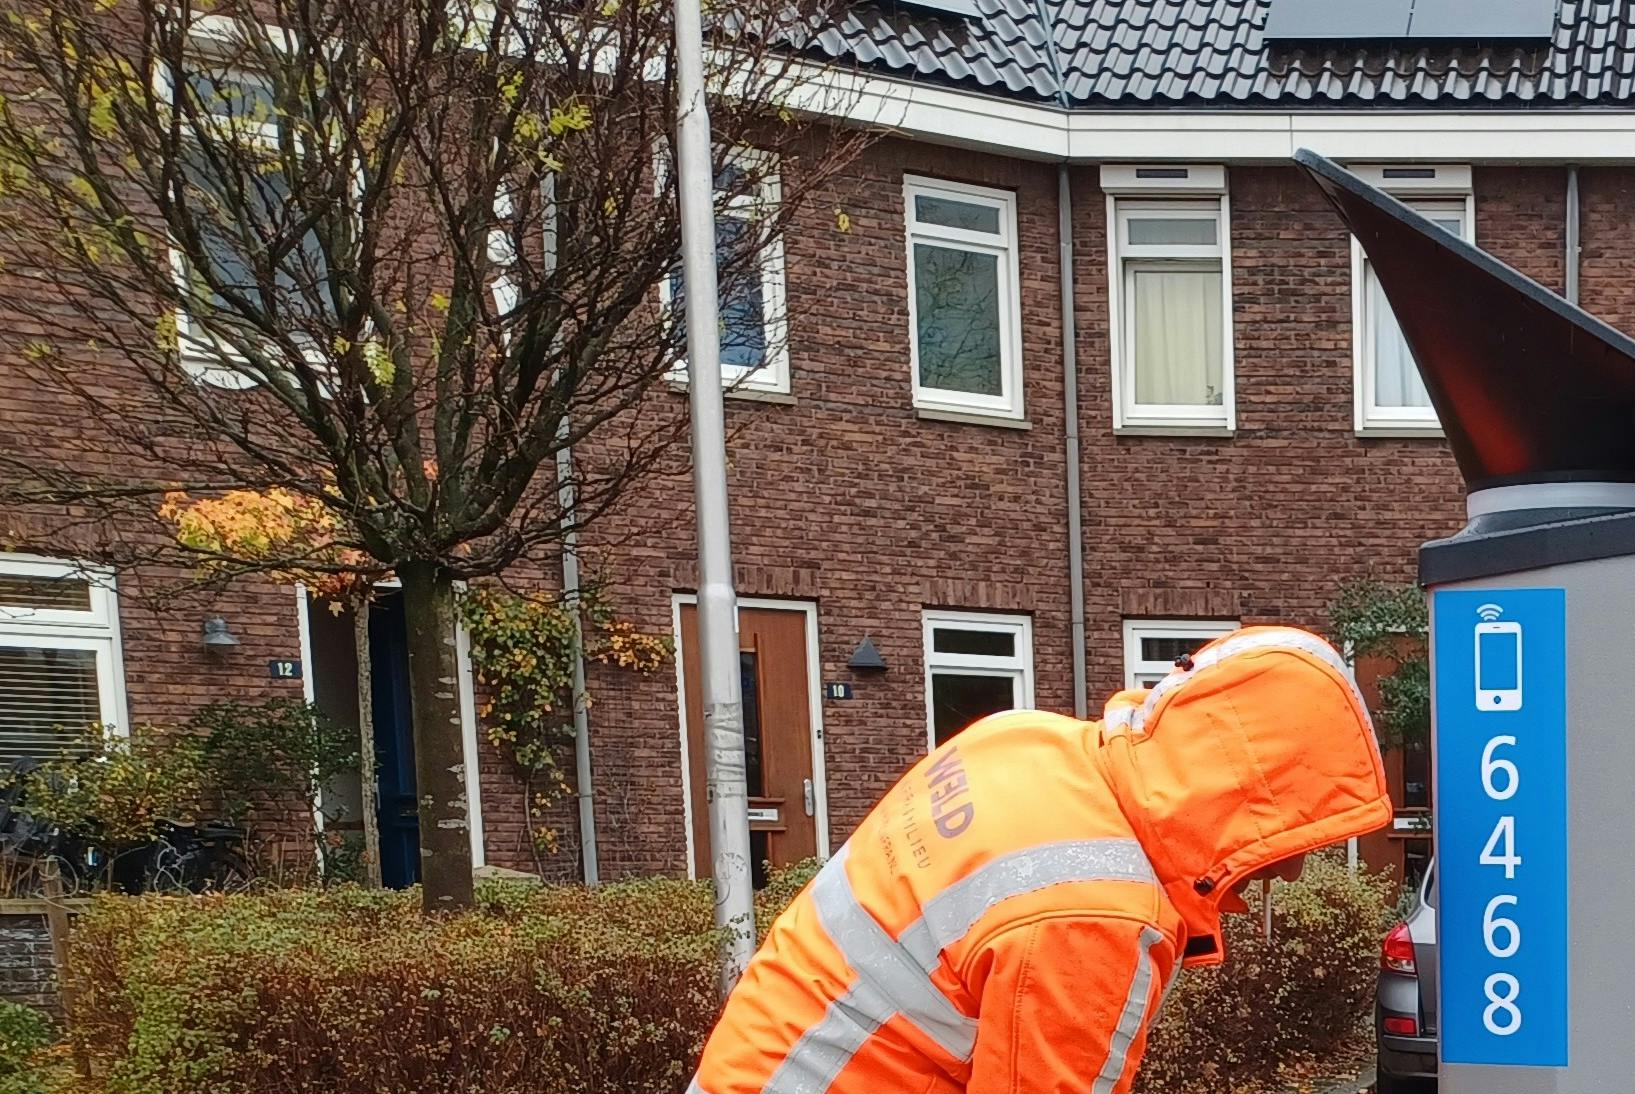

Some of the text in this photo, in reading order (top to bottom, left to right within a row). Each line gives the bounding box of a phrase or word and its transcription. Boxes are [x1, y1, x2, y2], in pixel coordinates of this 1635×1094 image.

[277, 662, 293, 677] 12
[832, 684, 845, 698] 10
[1479, 734, 1523, 1036] 6468
